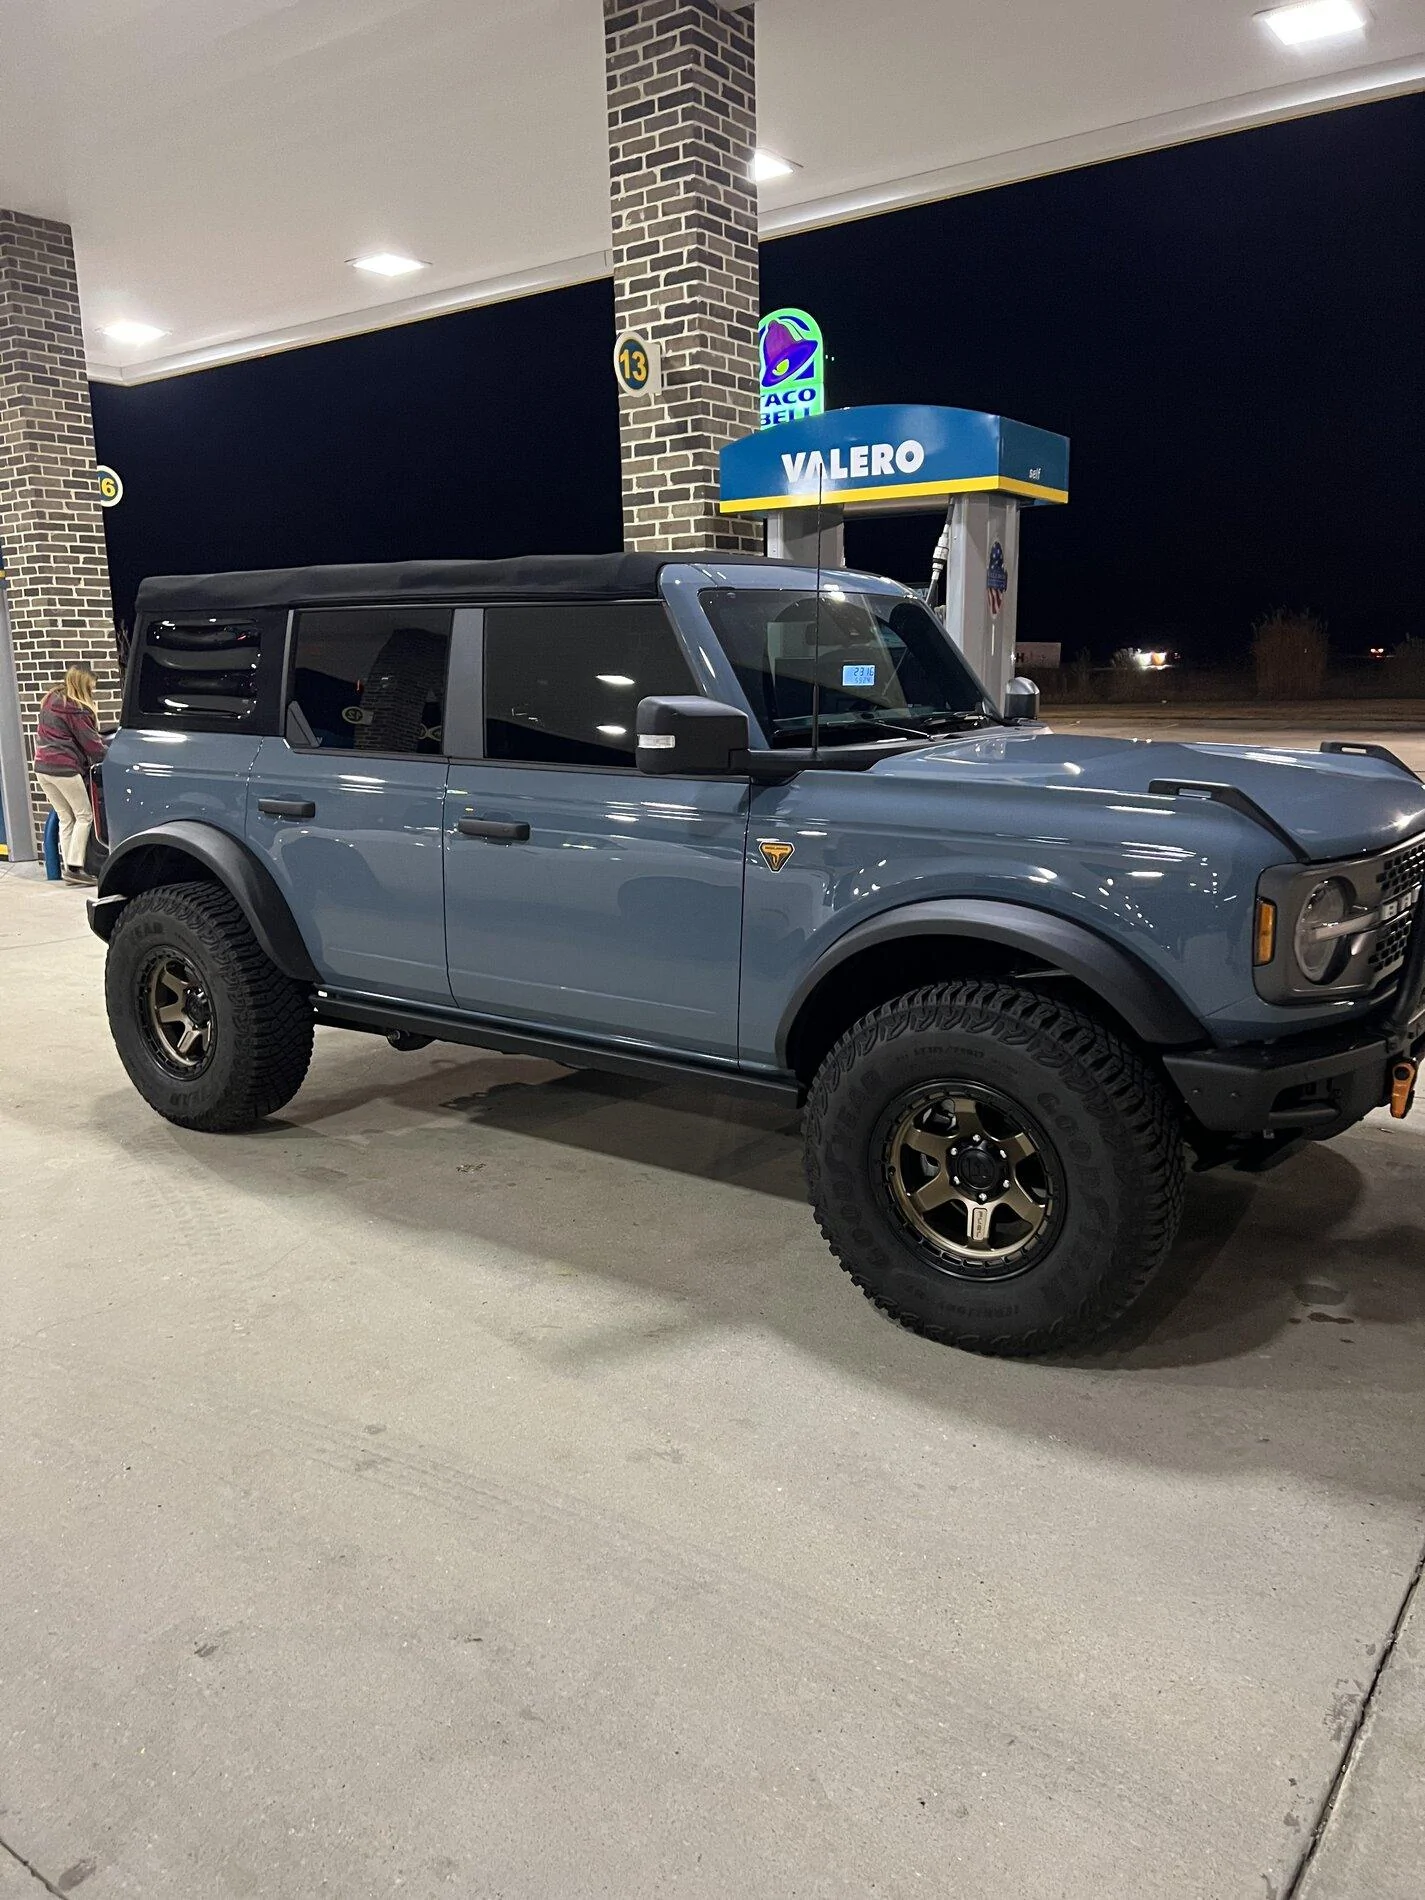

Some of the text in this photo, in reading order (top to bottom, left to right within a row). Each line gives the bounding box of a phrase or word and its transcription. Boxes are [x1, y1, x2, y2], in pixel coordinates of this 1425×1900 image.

[619, 349, 647, 381] 13
[760, 388, 817, 407] ACO
[781, 439, 925, 483] VALERO
